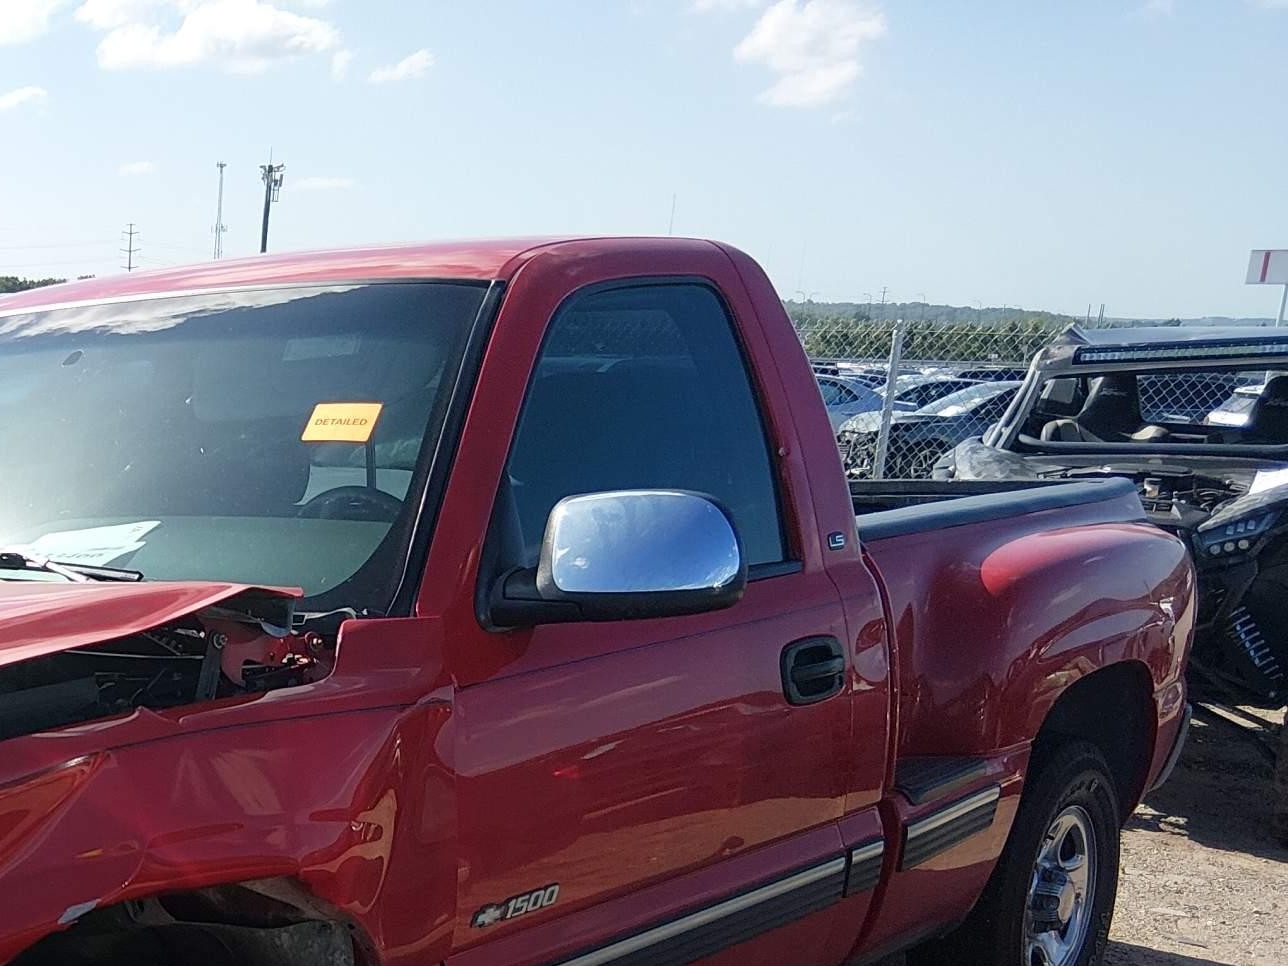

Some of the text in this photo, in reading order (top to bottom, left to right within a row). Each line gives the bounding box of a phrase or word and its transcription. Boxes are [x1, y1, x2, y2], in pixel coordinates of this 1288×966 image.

[315, 418, 368, 426] DETAILED
[828, 534, 845, 547] LS
[505, 884, 559, 919] 1500
